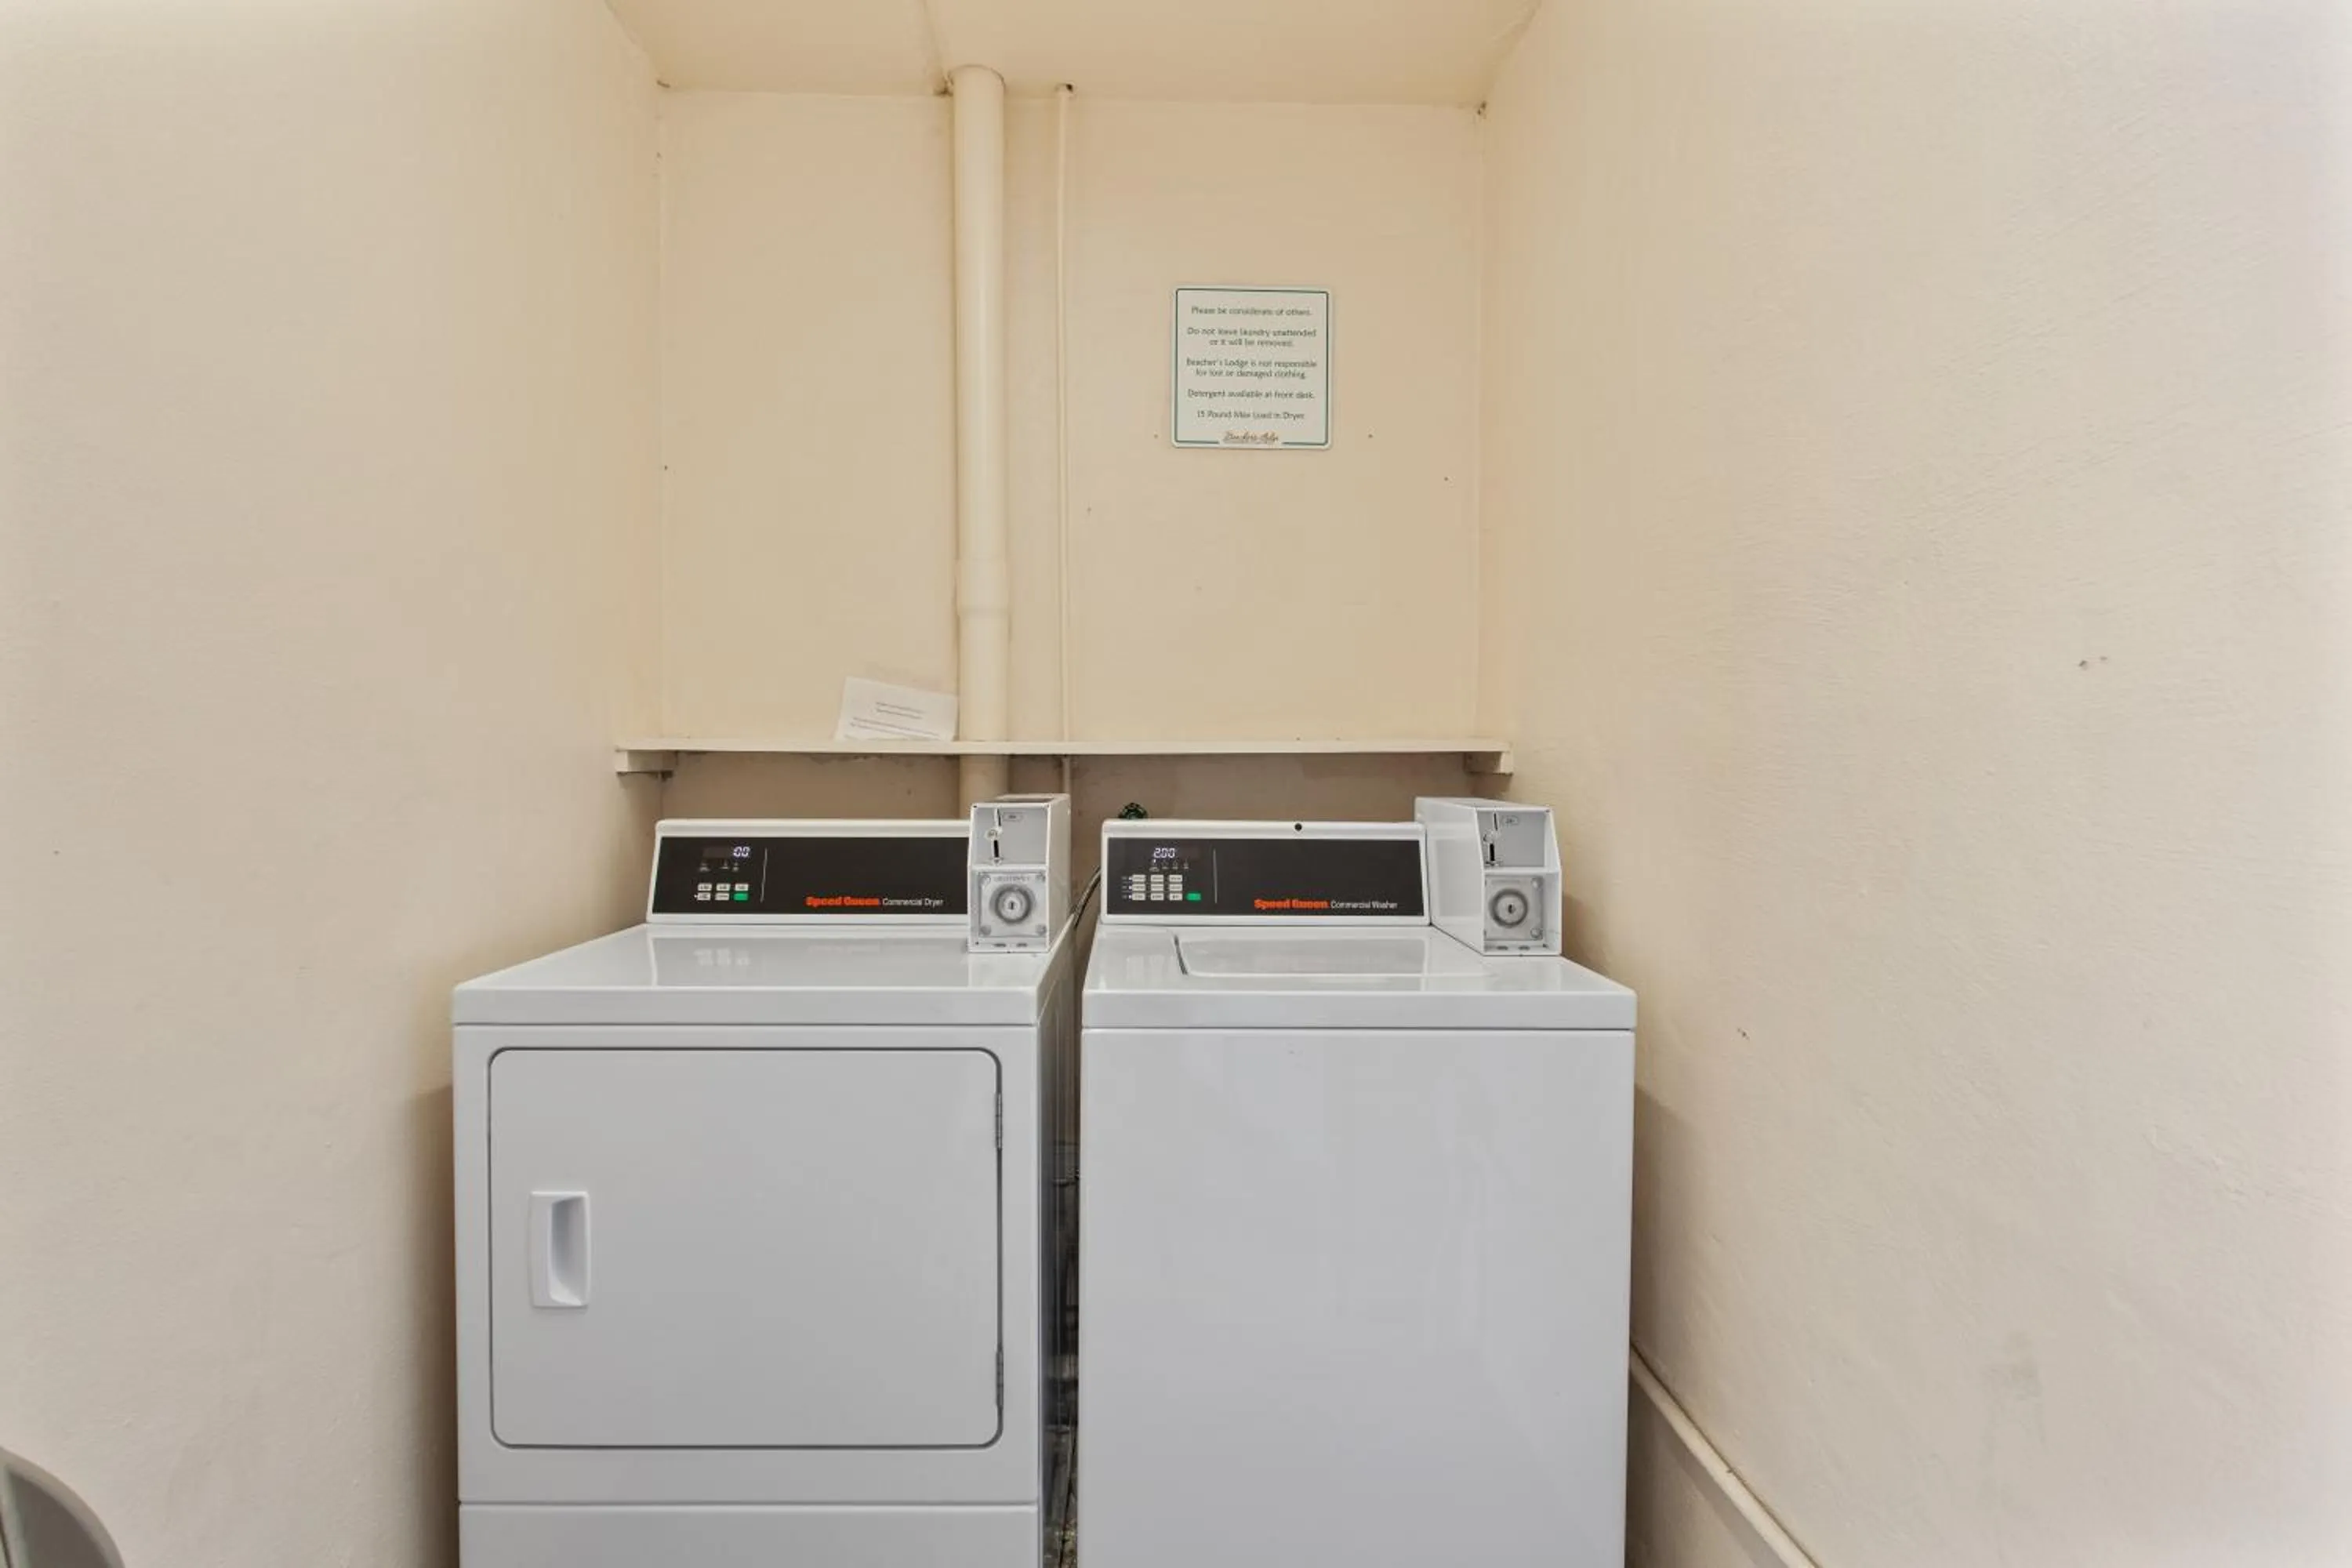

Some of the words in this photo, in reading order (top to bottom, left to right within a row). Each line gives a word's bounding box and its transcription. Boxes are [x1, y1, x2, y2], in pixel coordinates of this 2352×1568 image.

[1191, 306, 1215, 314] Please
[1229, 307, 1274, 315] considerate
[1187, 327, 1200, 336] Do
[1240, 328, 1270, 337] laundry
[1272, 328, 1317, 337] unattended
[1225, 358, 1248, 368] Lodge
[1274, 360, 1317, 368] responsible
[1236, 369, 1272, 379] damaged
[1188, 388, 1225, 398] Detergent
[1229, 390, 1263, 398] available
[1283, 412, 1305, 421] Dryer
[805, 896, 842, 909] Speed
[843, 896, 880, 907] Queen
[882, 897, 922, 906] Commercial
[924, 898, 944, 909] Dryer
[1254, 898, 1291, 910] Speed
[1292, 898, 1329, 909] Queen
[1330, 899, 1371, 909] Commercial
[1371, 899, 1398, 909] Washer
